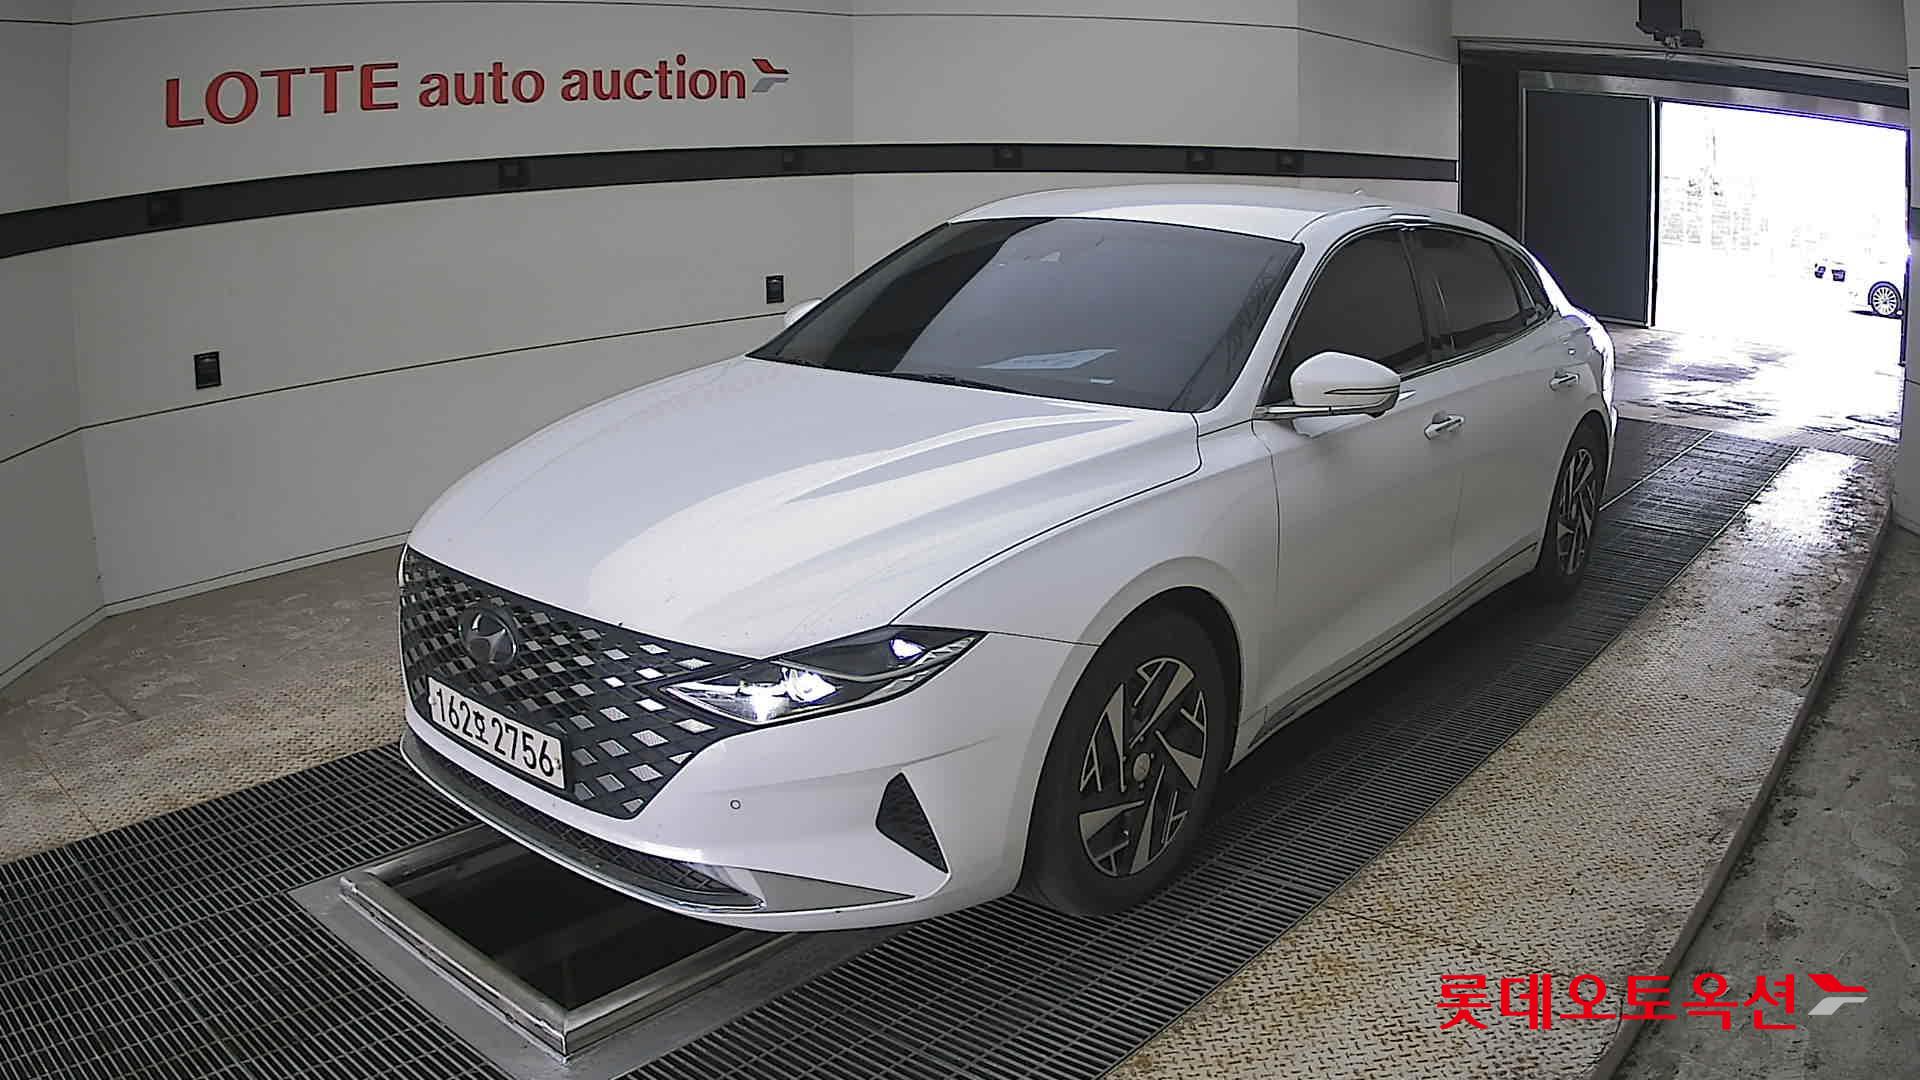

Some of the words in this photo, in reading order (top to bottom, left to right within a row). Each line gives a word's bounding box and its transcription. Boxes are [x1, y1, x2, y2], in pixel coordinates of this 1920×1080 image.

[164, 62, 399, 128] LOTTE
[418, 62, 546, 107] auto
[560, 54, 747, 101] auction
